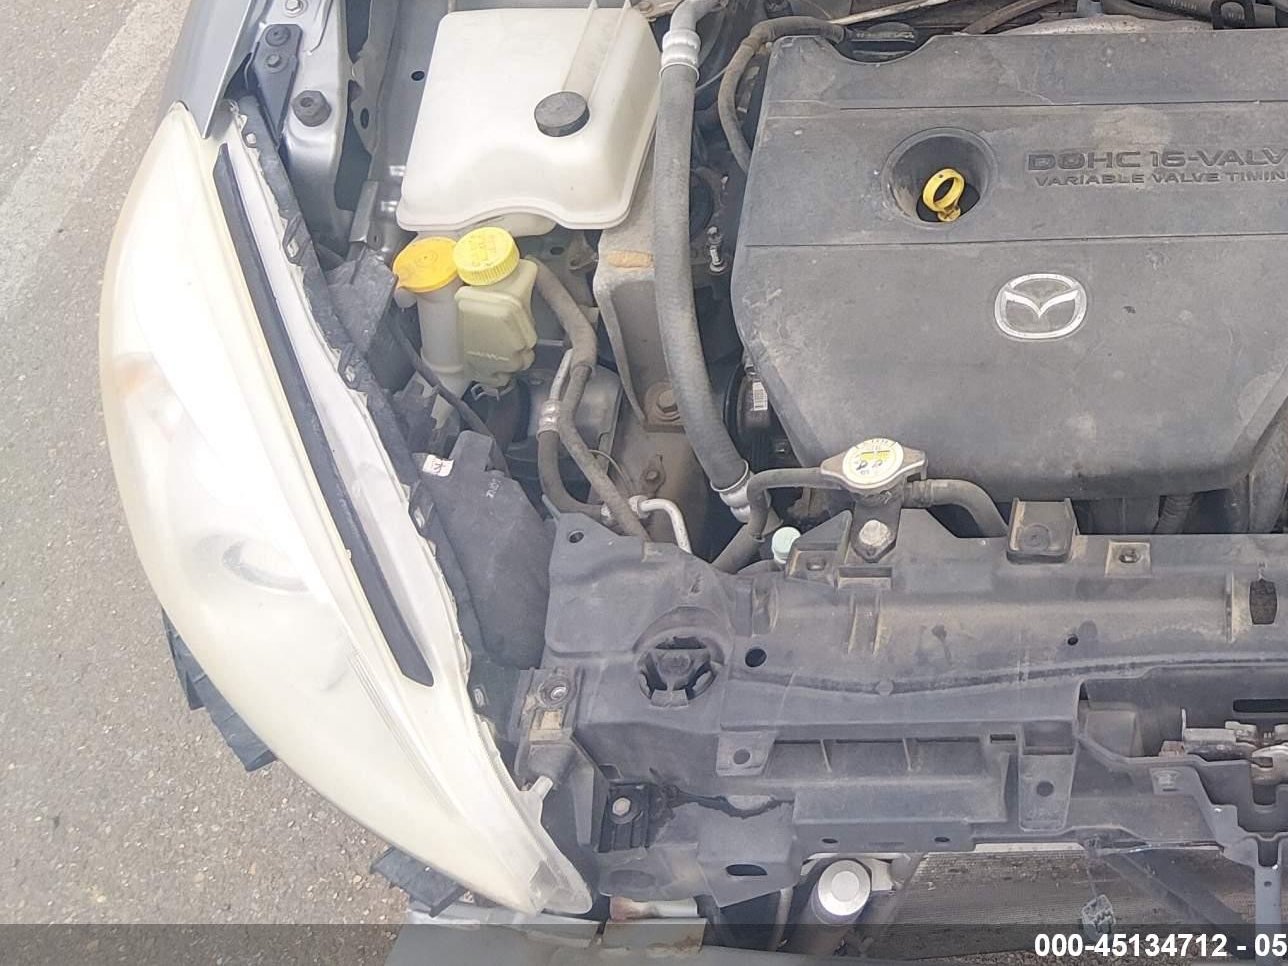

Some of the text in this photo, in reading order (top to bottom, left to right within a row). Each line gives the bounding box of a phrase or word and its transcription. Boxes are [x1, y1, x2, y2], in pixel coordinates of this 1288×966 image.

[1027, 150, 1142, 171] DOHC
[1034, 173, 1146, 187] VARIABLE
[1150, 172, 1220, 184] VALVE
